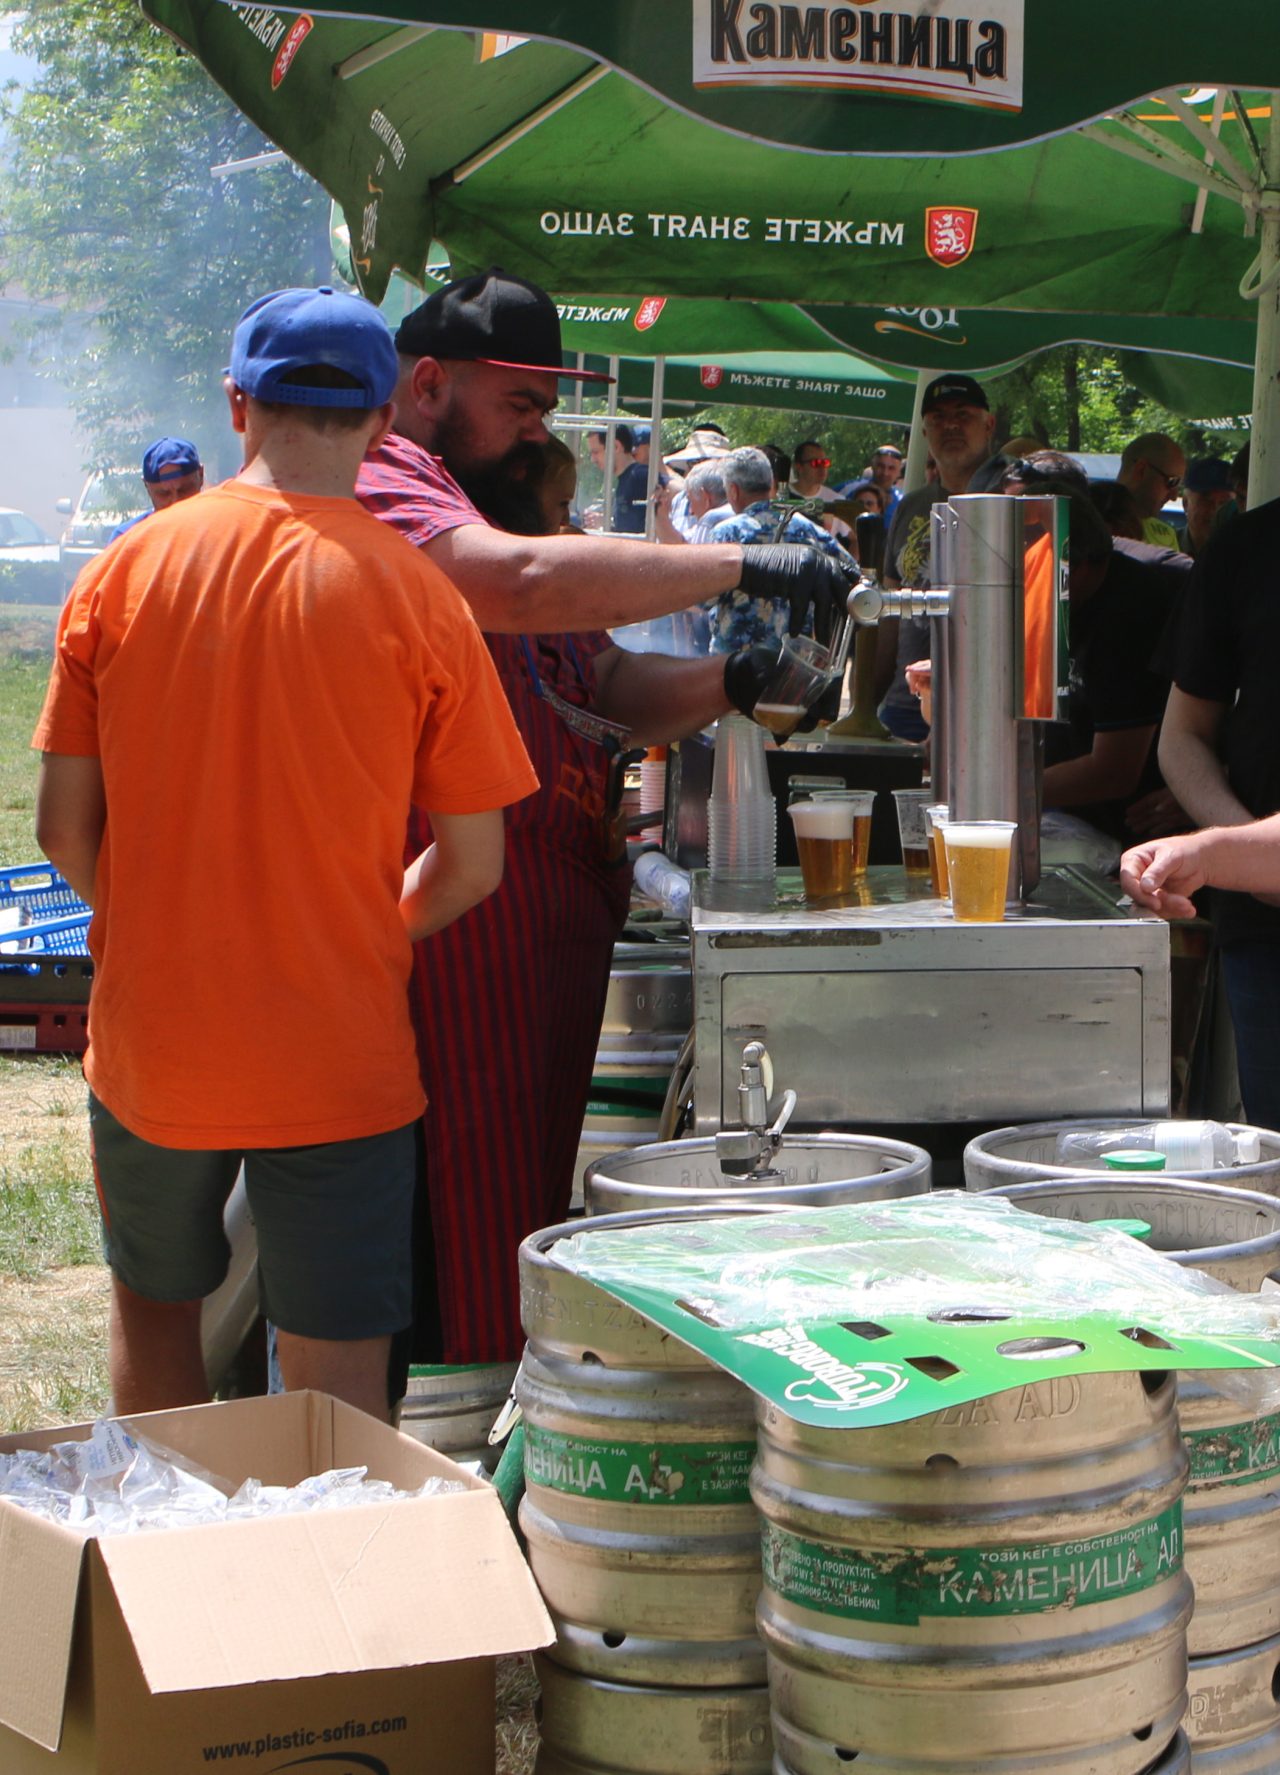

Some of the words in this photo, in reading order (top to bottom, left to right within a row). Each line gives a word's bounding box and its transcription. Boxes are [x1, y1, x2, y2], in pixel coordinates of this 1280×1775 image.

[710, 0, 1008, 85] Каменица
[730, 373, 790, 389] МЪЖЕТЕ
[795, 379, 841, 395] ЗНАЯТ
[939, 1548, 1143, 1604] КАМЕНИЦА
[1157, 1527, 1178, 1570] АД
[979, 1552, 1020, 1563] ТОЗИ
[1022, 1549, 1049, 1561] КЕГ
[1053, 1546, 1061, 1557] Е
[1064, 1528, 1146, 1556] СОБСТВЕНОСТ
[1147, 1522, 1159, 1534] НА
[202, 1715, 408, 1762] www.plastic-sofia.com
